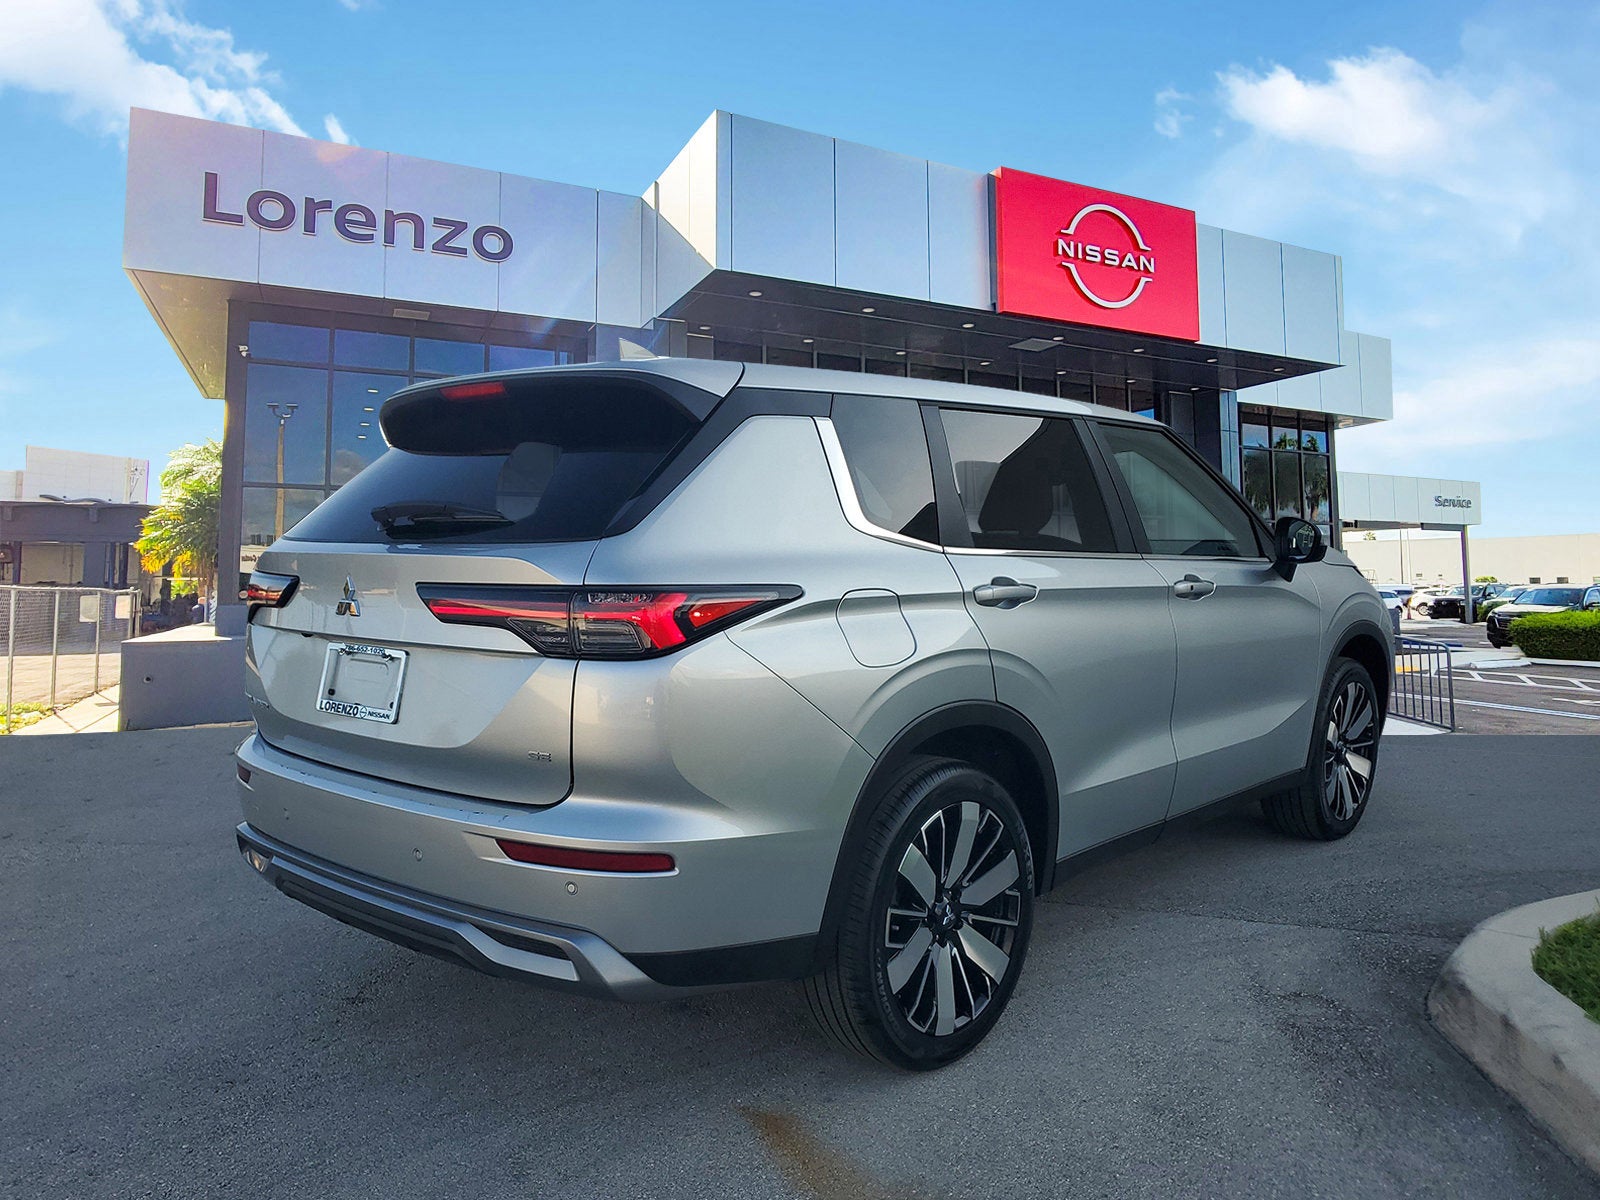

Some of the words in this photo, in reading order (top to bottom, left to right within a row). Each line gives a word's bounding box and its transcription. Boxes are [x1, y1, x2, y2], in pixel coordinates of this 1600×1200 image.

[202, 171, 514, 263] Lorenzo
[1056, 238, 1155, 273] NISSAN
[1434, 495, 1472, 509] Service
[319, 700, 359, 717] LORENZO
[367, 710, 391, 720] NISSAN
